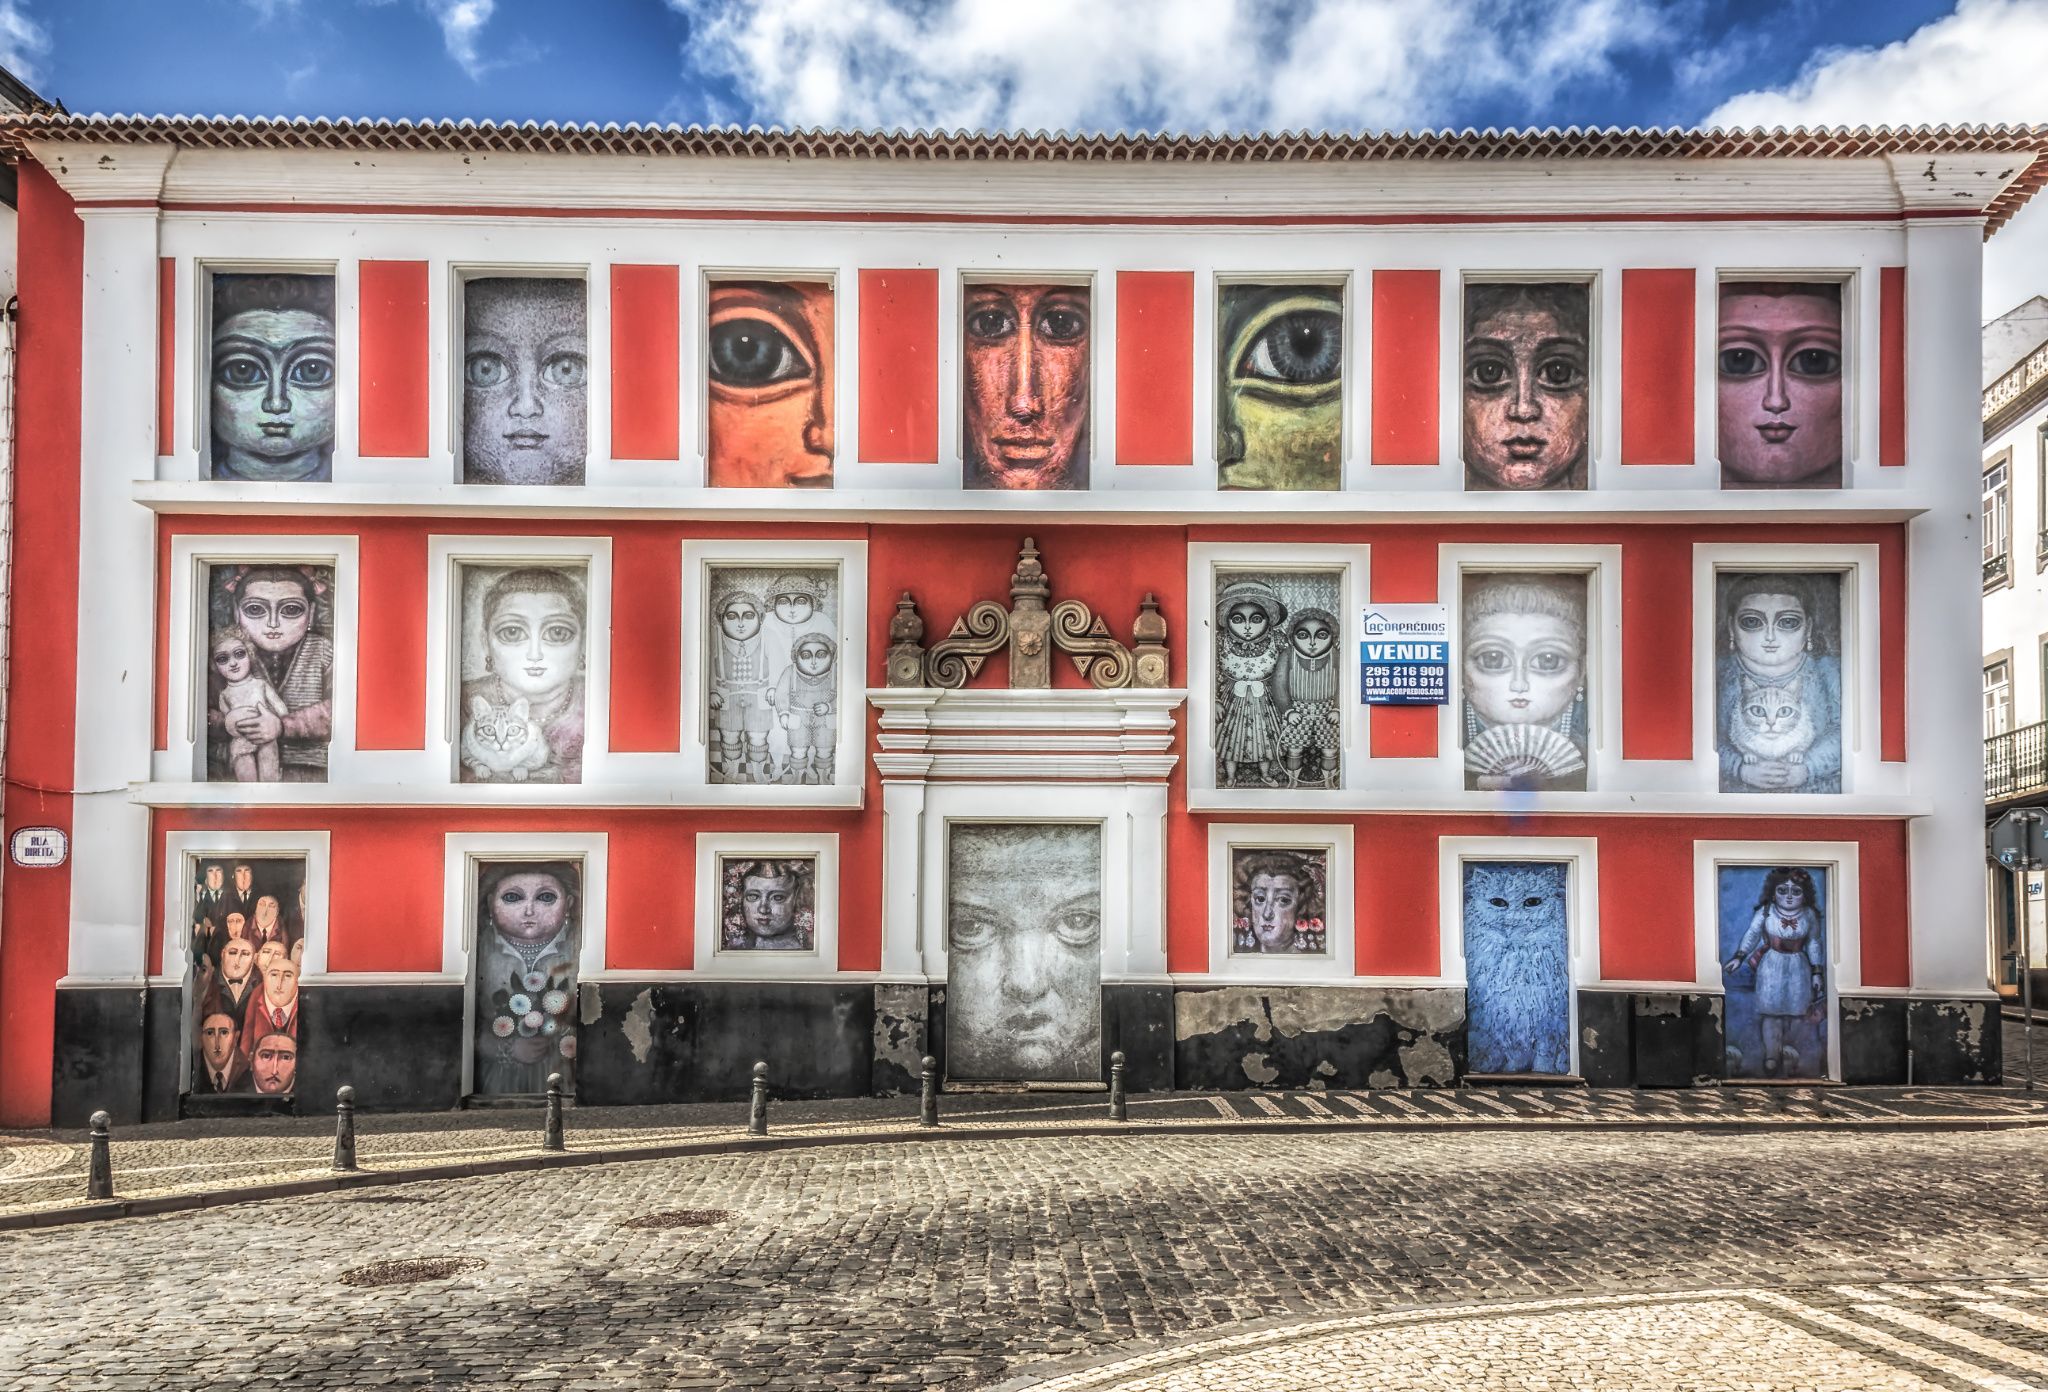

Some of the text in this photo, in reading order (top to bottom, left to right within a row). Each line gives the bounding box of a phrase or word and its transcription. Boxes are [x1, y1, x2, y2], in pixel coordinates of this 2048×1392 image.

[1367, 644, 1442, 660] VENDE
[1366, 666, 1444, 676] 295 216 900
[1366, 677, 1444, 687] 919 016 914
[1366, 688, 1444, 696] WWW.ACORPREDIOS.COM
[31, 836, 49, 846] RUA
[25, 847, 54, 857] DIREITA
